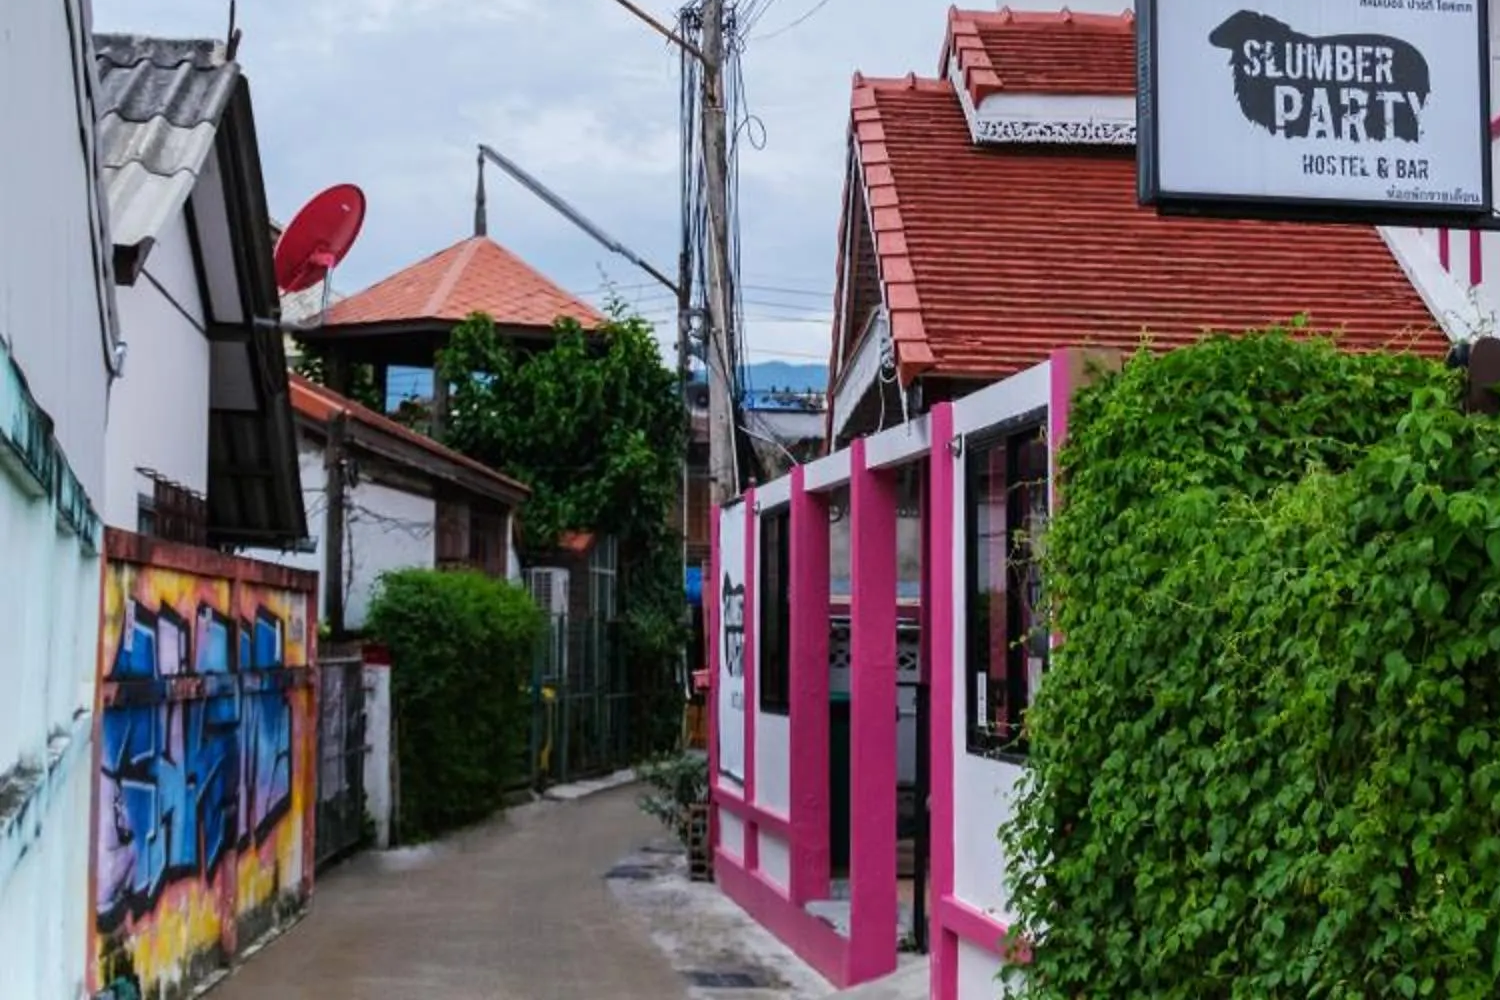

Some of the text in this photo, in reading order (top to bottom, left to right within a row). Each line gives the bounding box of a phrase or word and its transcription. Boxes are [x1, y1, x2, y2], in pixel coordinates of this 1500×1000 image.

[1243, 39, 1394, 84] SLUMBER
[1273, 85, 1430, 143] PARTY
[1302, 153, 1429, 180] HOSTEL & BAR
